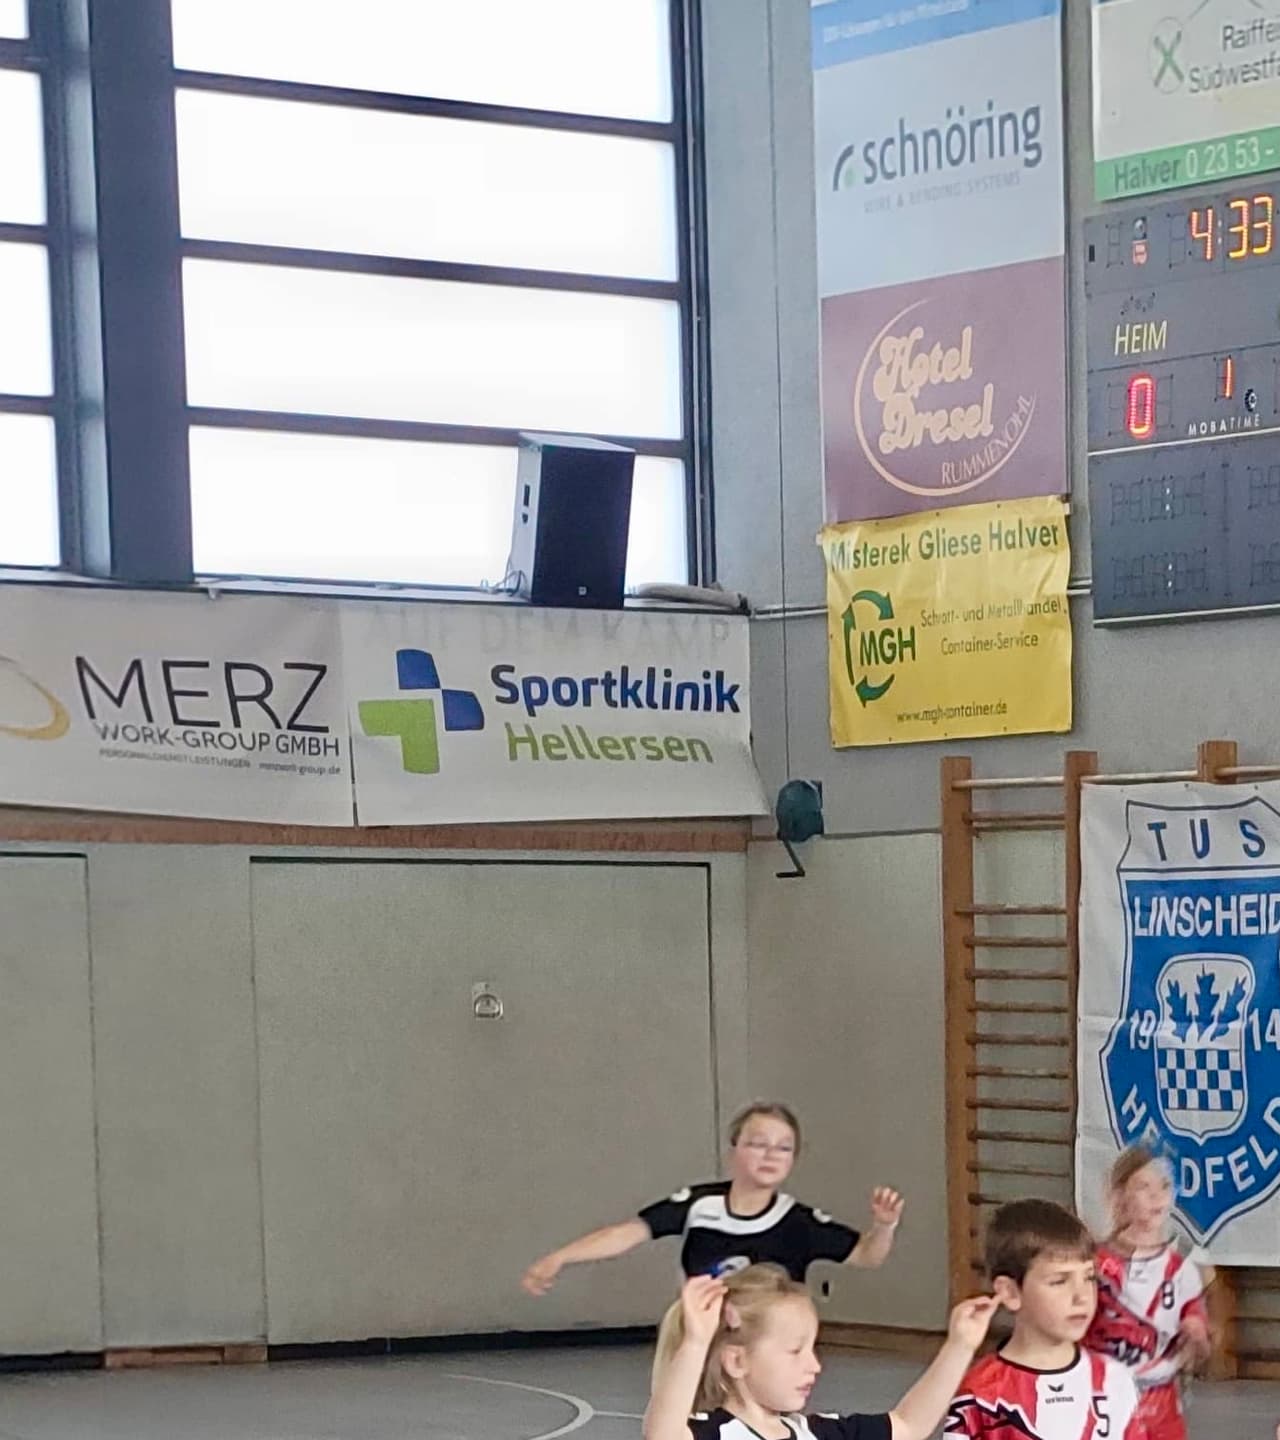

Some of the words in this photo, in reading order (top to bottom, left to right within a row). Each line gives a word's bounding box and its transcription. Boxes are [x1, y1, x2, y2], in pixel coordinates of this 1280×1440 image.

[862, 99, 1043, 169] schnöring
[1113, 158, 1181, 193] Halver
[1184, 148, 1199, 179] 0
[1203, 143, 1230, 176] 23
[1234, 136, 1261, 169] 53
[1189, 195, 1275, 261] 4:33
[1114, 320, 1169, 357] HEIM
[1129, 375, 1154, 436] 0
[1188, 413, 1261, 437] MOBATIME
[918, 526, 983, 561] Gliese
[988, 518, 1060, 551] Halver
[962, 605, 984, 623] und
[859, 625, 917, 667] MGH
[940, 630, 1039, 656] Container-Service
[74, 655, 331, 734] MERZ
[490, 663, 742, 718] Sportklinik
[97, 721, 271, 753] WORK-GROUP
[274, 733, 341, 758] GMBH
[504, 721, 714, 764] Hellersen
[1128, 1008, 1158, 1051] 19
[1161, 1279, 1176, 1311] 8
[1091, 1395, 1111, 1438] 5
